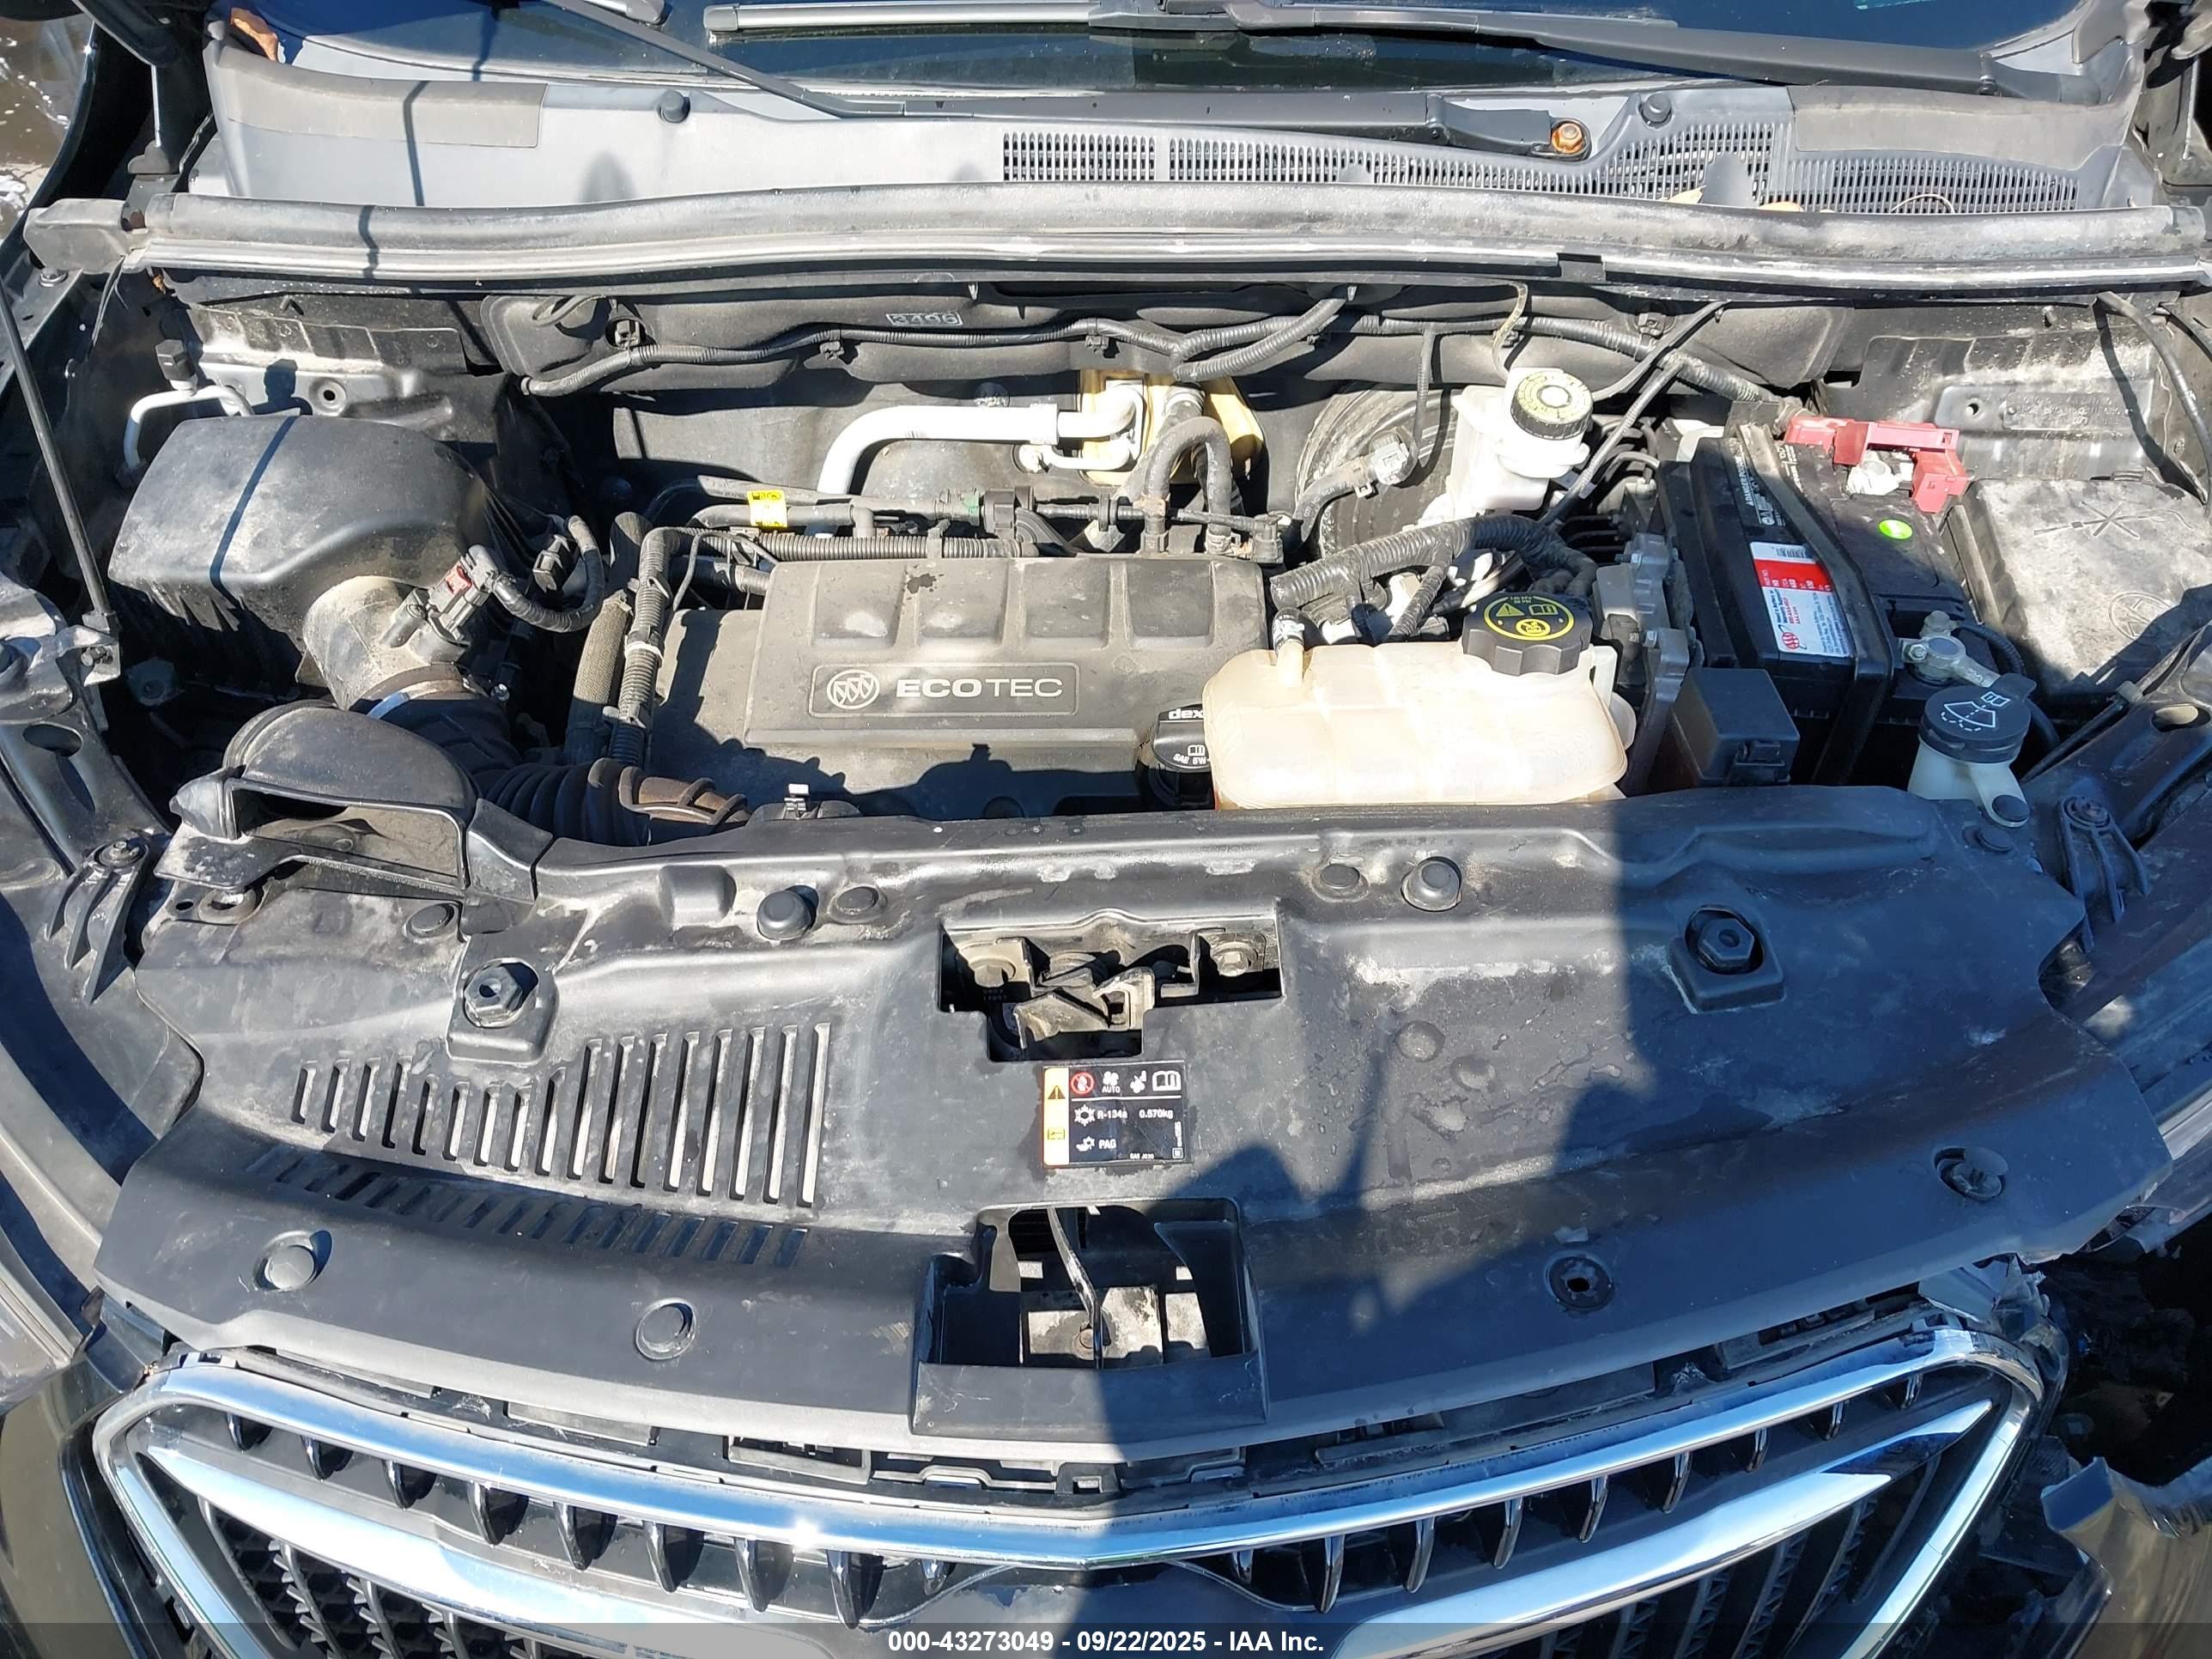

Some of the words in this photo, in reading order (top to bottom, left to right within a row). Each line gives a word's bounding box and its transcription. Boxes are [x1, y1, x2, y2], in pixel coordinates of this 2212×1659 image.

[896, 678, 1063, 697] ECOTEC
[1173, 753, 1189, 764] SAE
[1102, 1085, 1121, 1093] AUTO
[1097, 1109, 1128, 1120] R-134a
[1098, 1139, 1116, 1149] PAG
